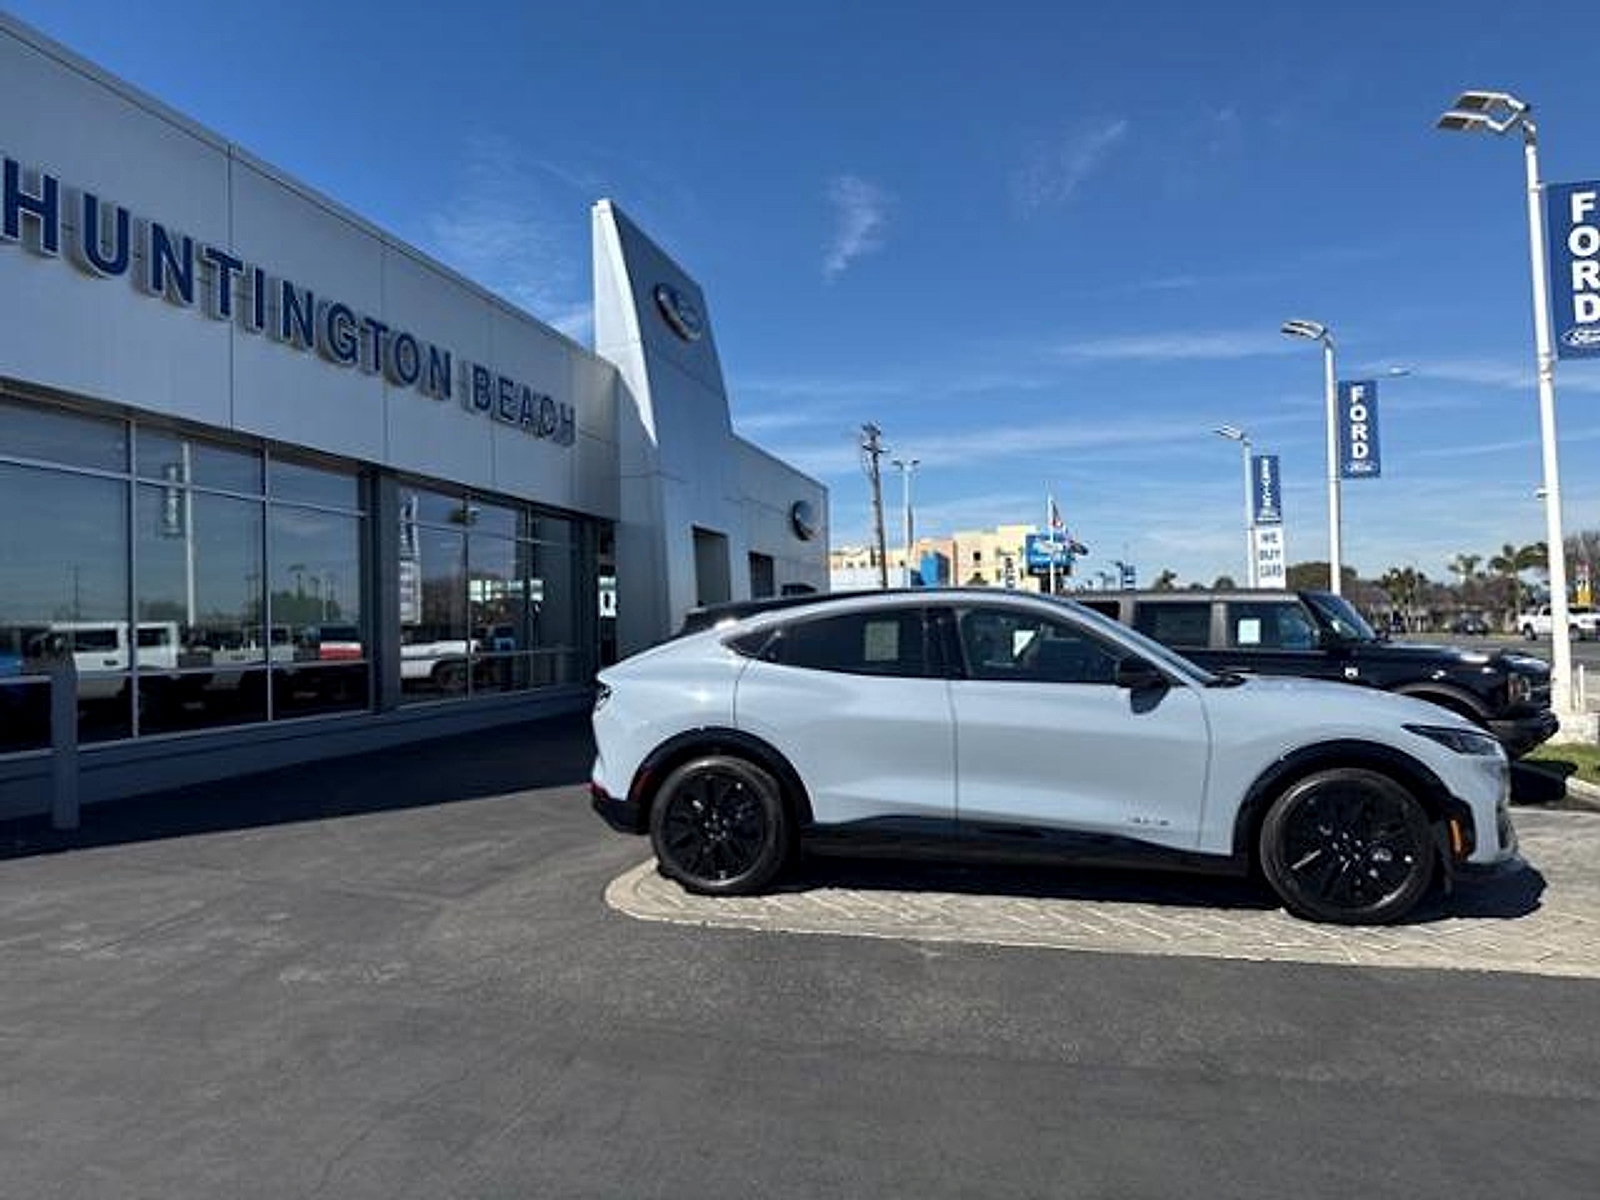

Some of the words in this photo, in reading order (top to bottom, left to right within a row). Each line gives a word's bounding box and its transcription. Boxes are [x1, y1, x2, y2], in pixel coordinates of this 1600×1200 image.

[2, 157, 452, 400] HUNTINGTON
[473, 364, 575, 445] BEACH
[1568, 192, 1600, 323] FORD
[1350, 385, 1369, 459] FORD
